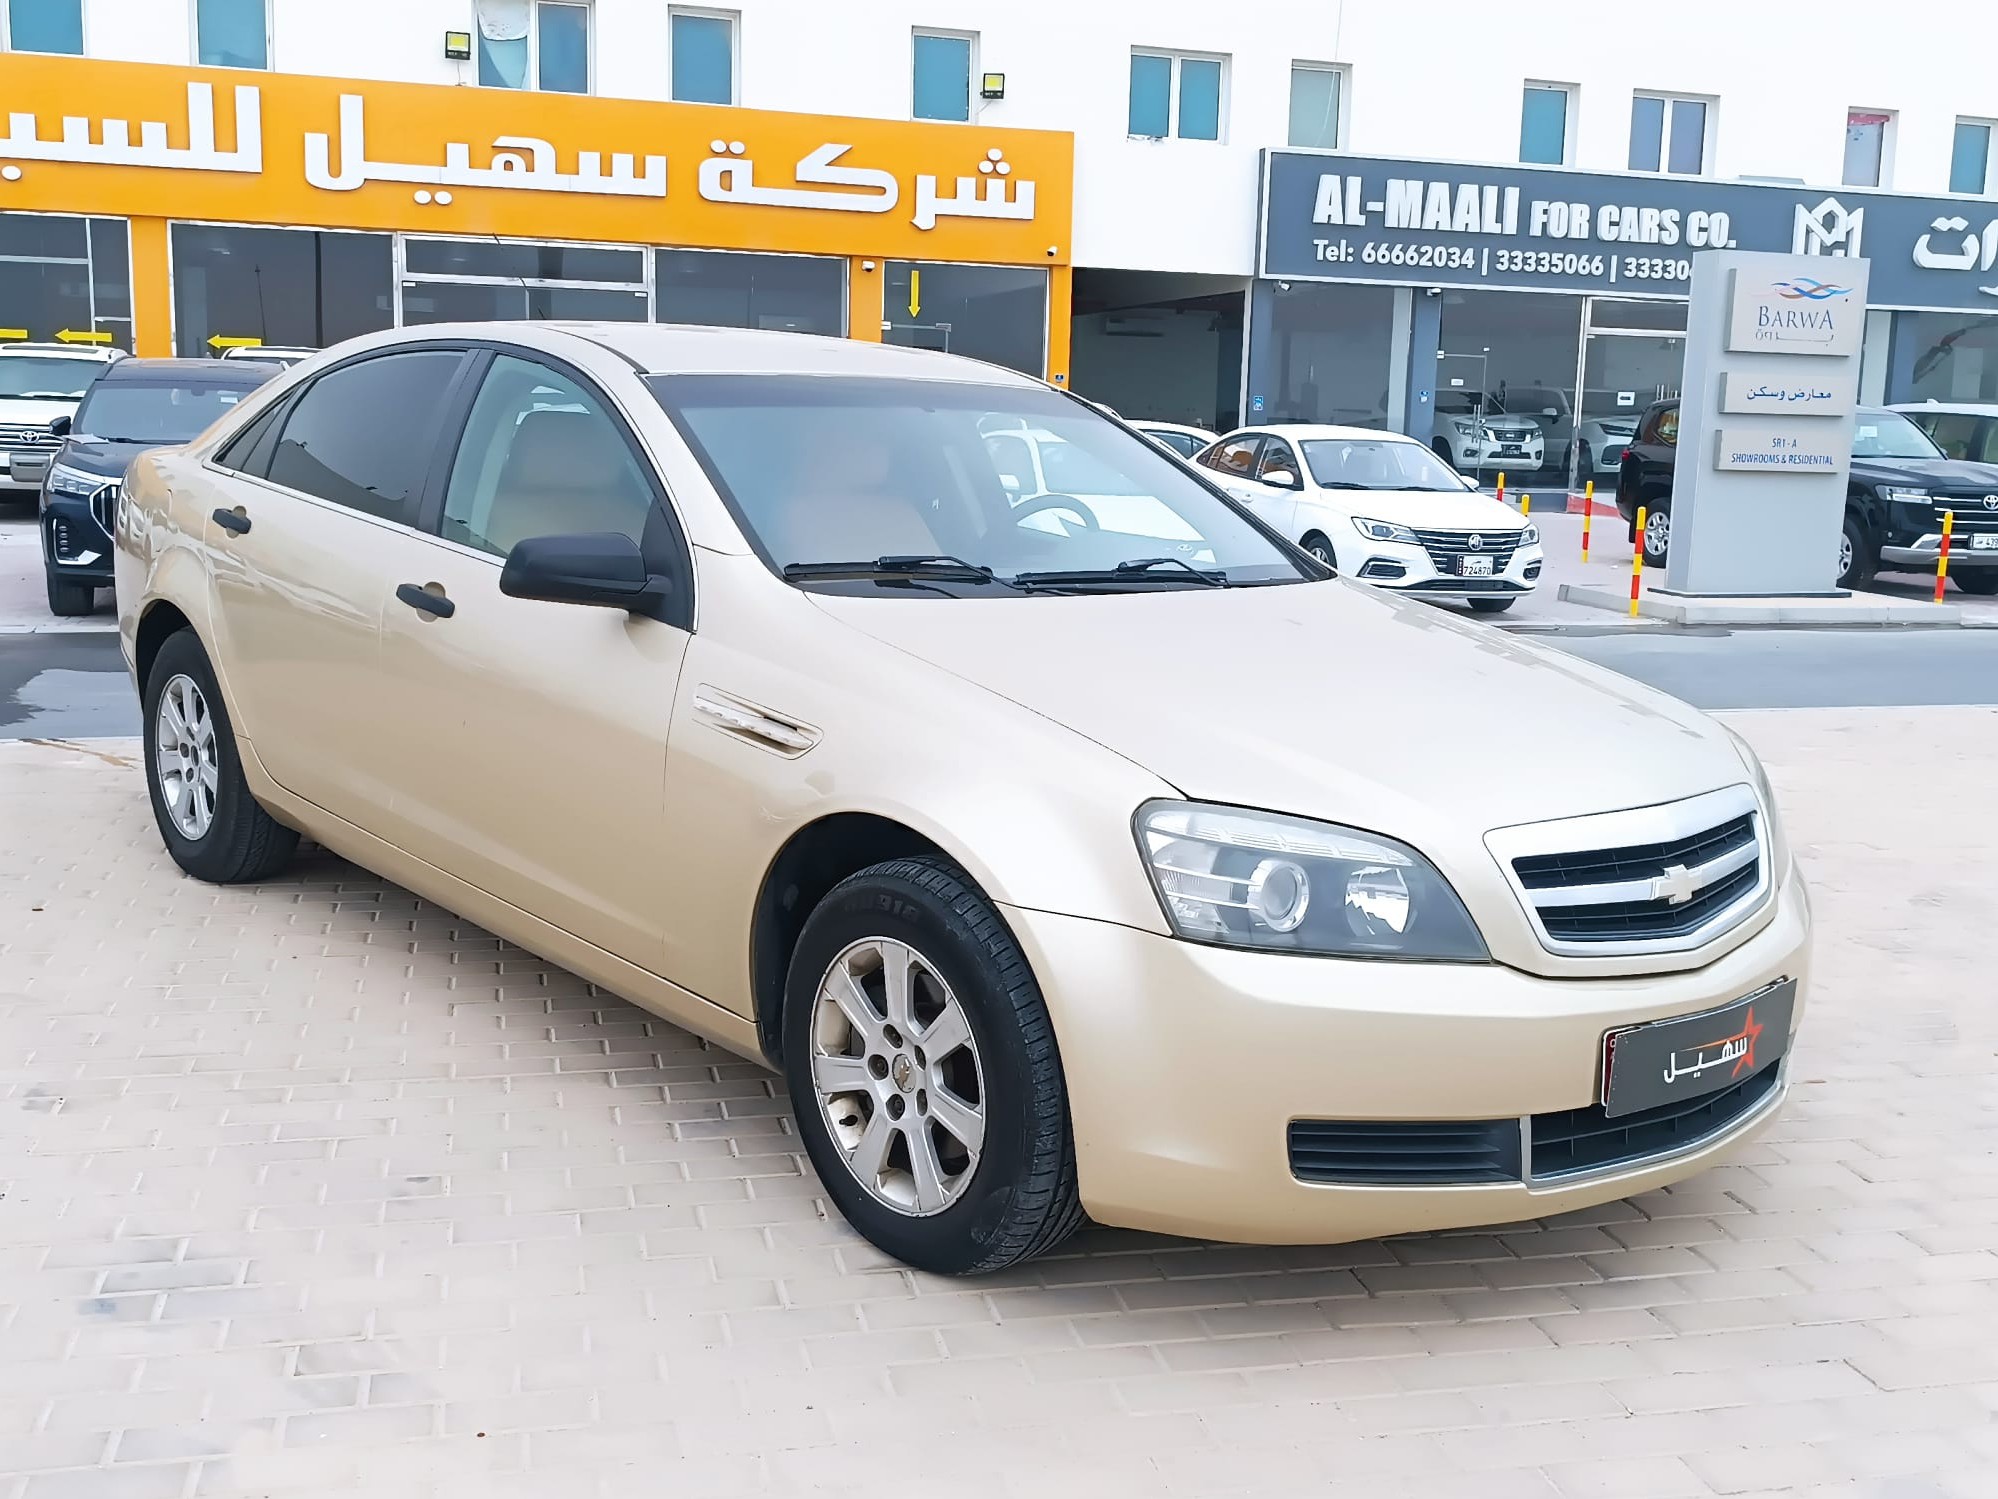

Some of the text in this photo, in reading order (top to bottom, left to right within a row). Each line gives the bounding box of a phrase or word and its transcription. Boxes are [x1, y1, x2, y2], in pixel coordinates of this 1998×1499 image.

[304, 94, 668, 206] سهيل
[698, 139, 1036, 231] شركة
[1312, 173, 1738, 249] AL-MAALI FOR CARS CO.
[1312, 239, 1354, 263] Tel:
[1361, 242, 1476, 270] 66662034
[1495, 248, 1604, 277] 33335066
[1624, 256, 1693, 281] 33330
[1746, 386, 1832, 402] معارض وسكن
[1731, 453, 1834, 466] SHOWROOMS & RESIDENTIAL
[1663, 1036, 1748, 1084] سهيل
